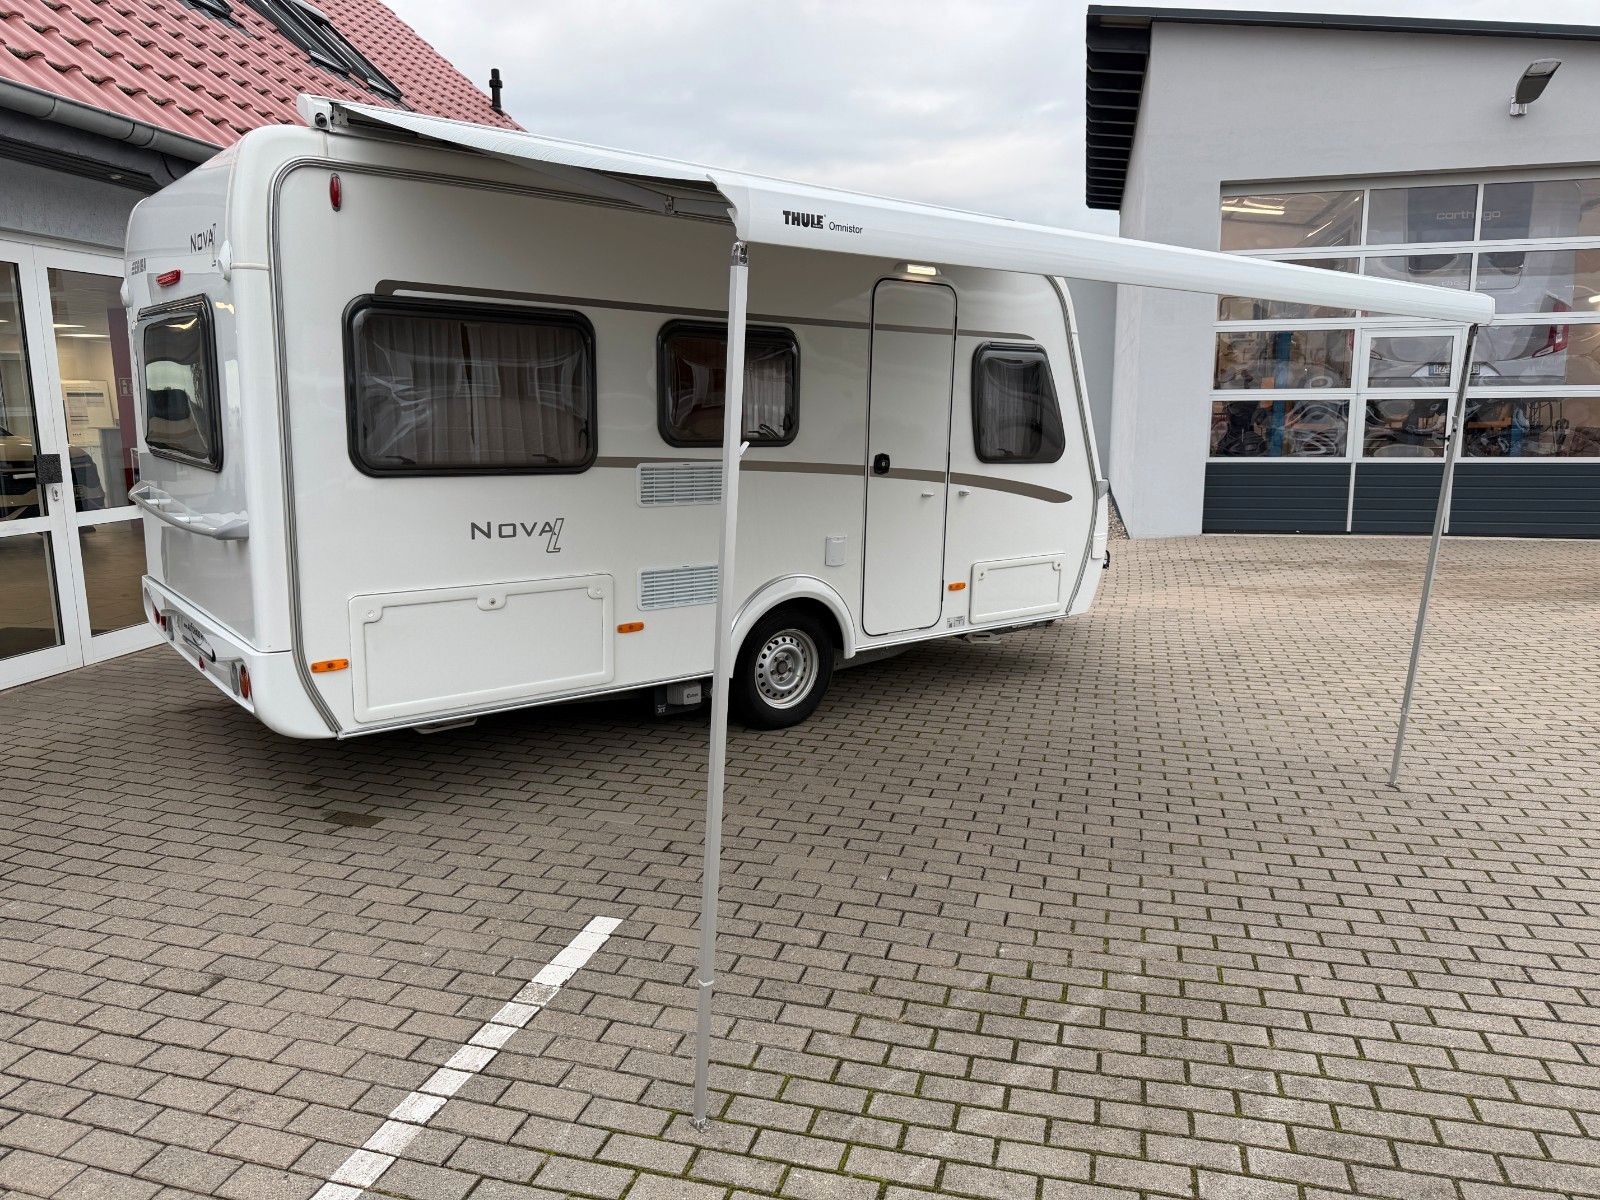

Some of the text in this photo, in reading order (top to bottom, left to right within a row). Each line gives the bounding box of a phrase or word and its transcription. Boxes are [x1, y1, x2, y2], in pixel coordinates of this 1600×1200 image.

[782, 210, 863, 234] THULE Omnistor
[1436, 210, 1501, 221] carthgo
